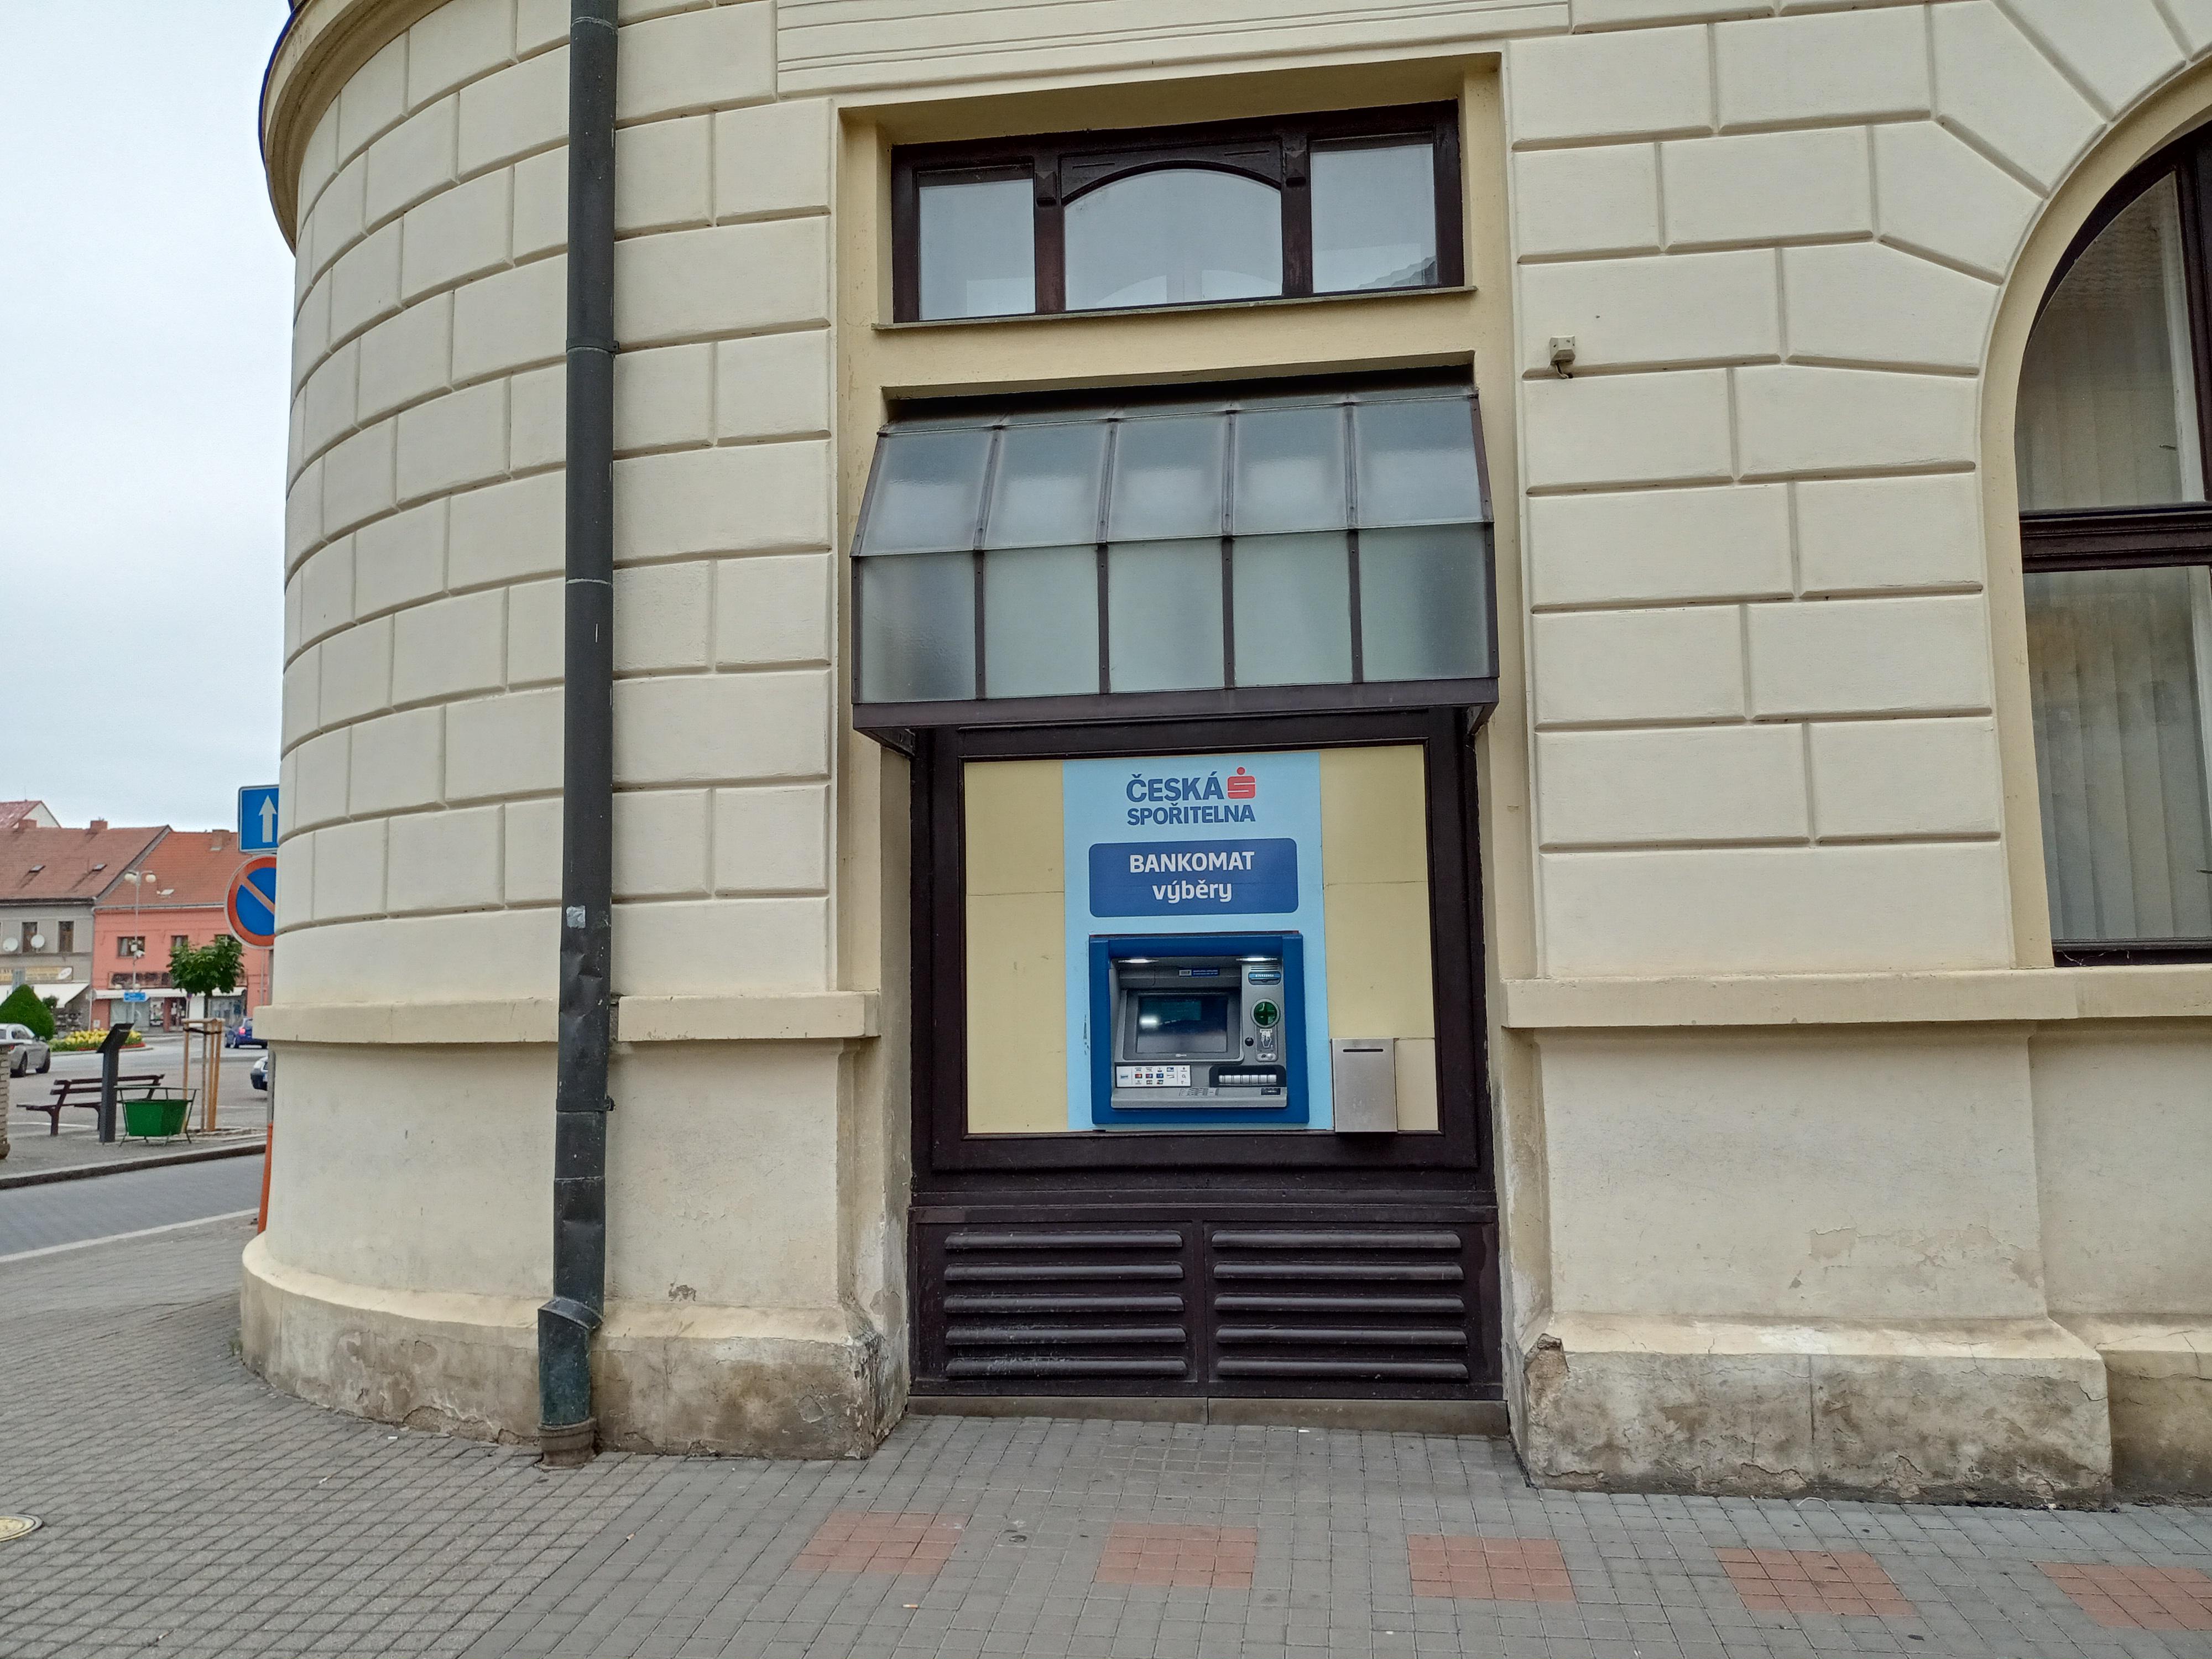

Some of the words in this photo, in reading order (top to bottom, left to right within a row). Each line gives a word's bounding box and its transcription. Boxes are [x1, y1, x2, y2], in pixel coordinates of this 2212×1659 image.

[1126, 771, 1225, 802] ČESKÁ
[1126, 802, 1256, 826] SPOŘITELNA
[1130, 851, 1255, 873] BANKOMAT
[1152, 879, 1232, 904] výběry
